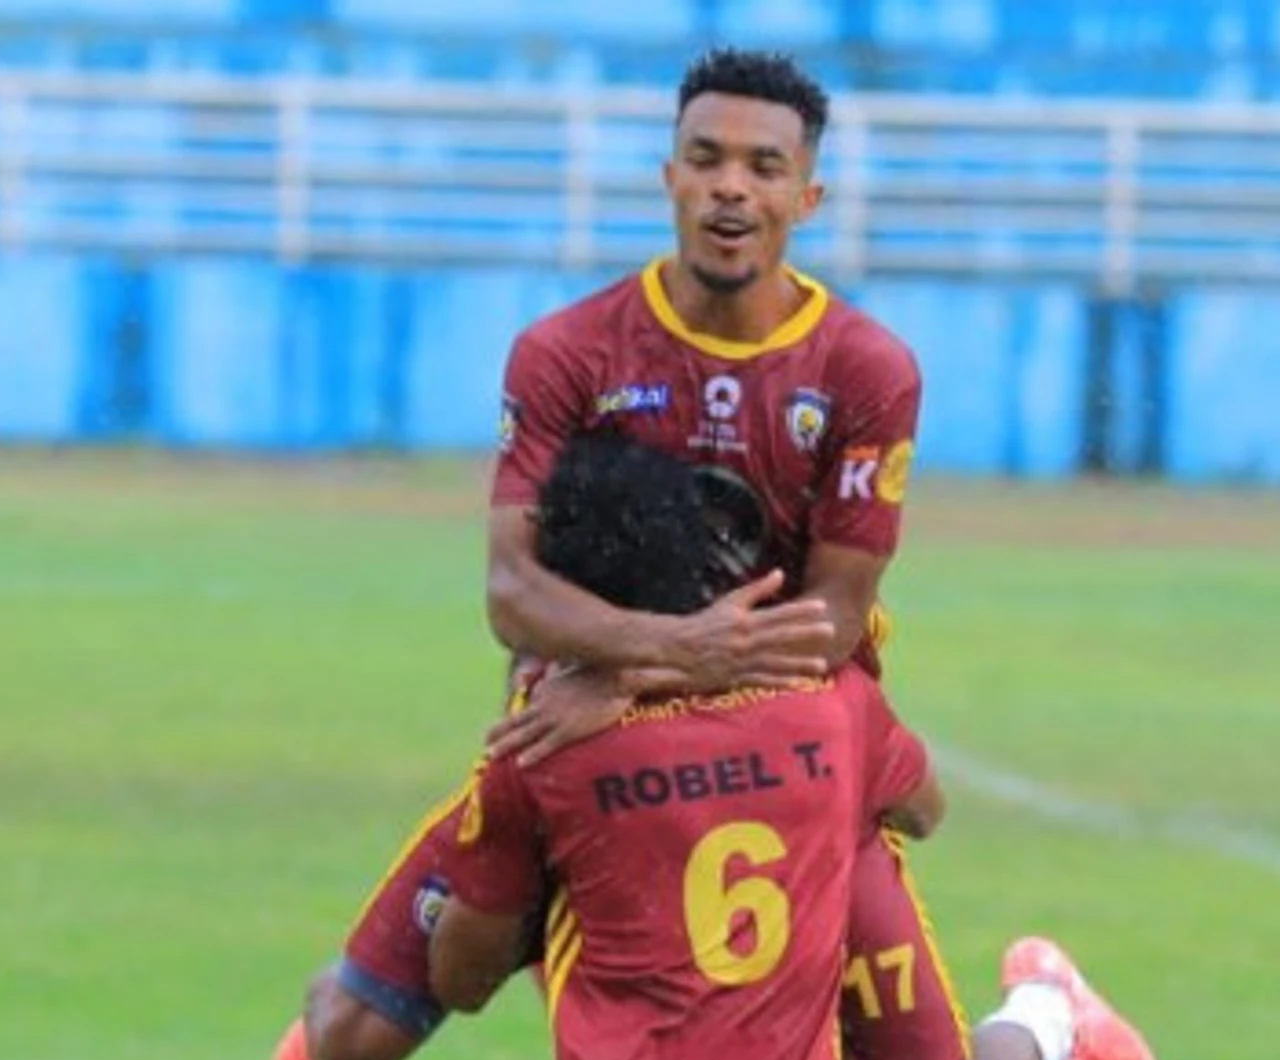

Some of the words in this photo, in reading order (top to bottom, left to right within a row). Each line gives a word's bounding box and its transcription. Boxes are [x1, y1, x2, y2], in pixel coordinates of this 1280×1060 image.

[593, 752, 784, 815] ROBEL
[791, 741, 833, 780] T.
[684, 821, 790, 984] 6
[844, 943, 916, 1019] 17
